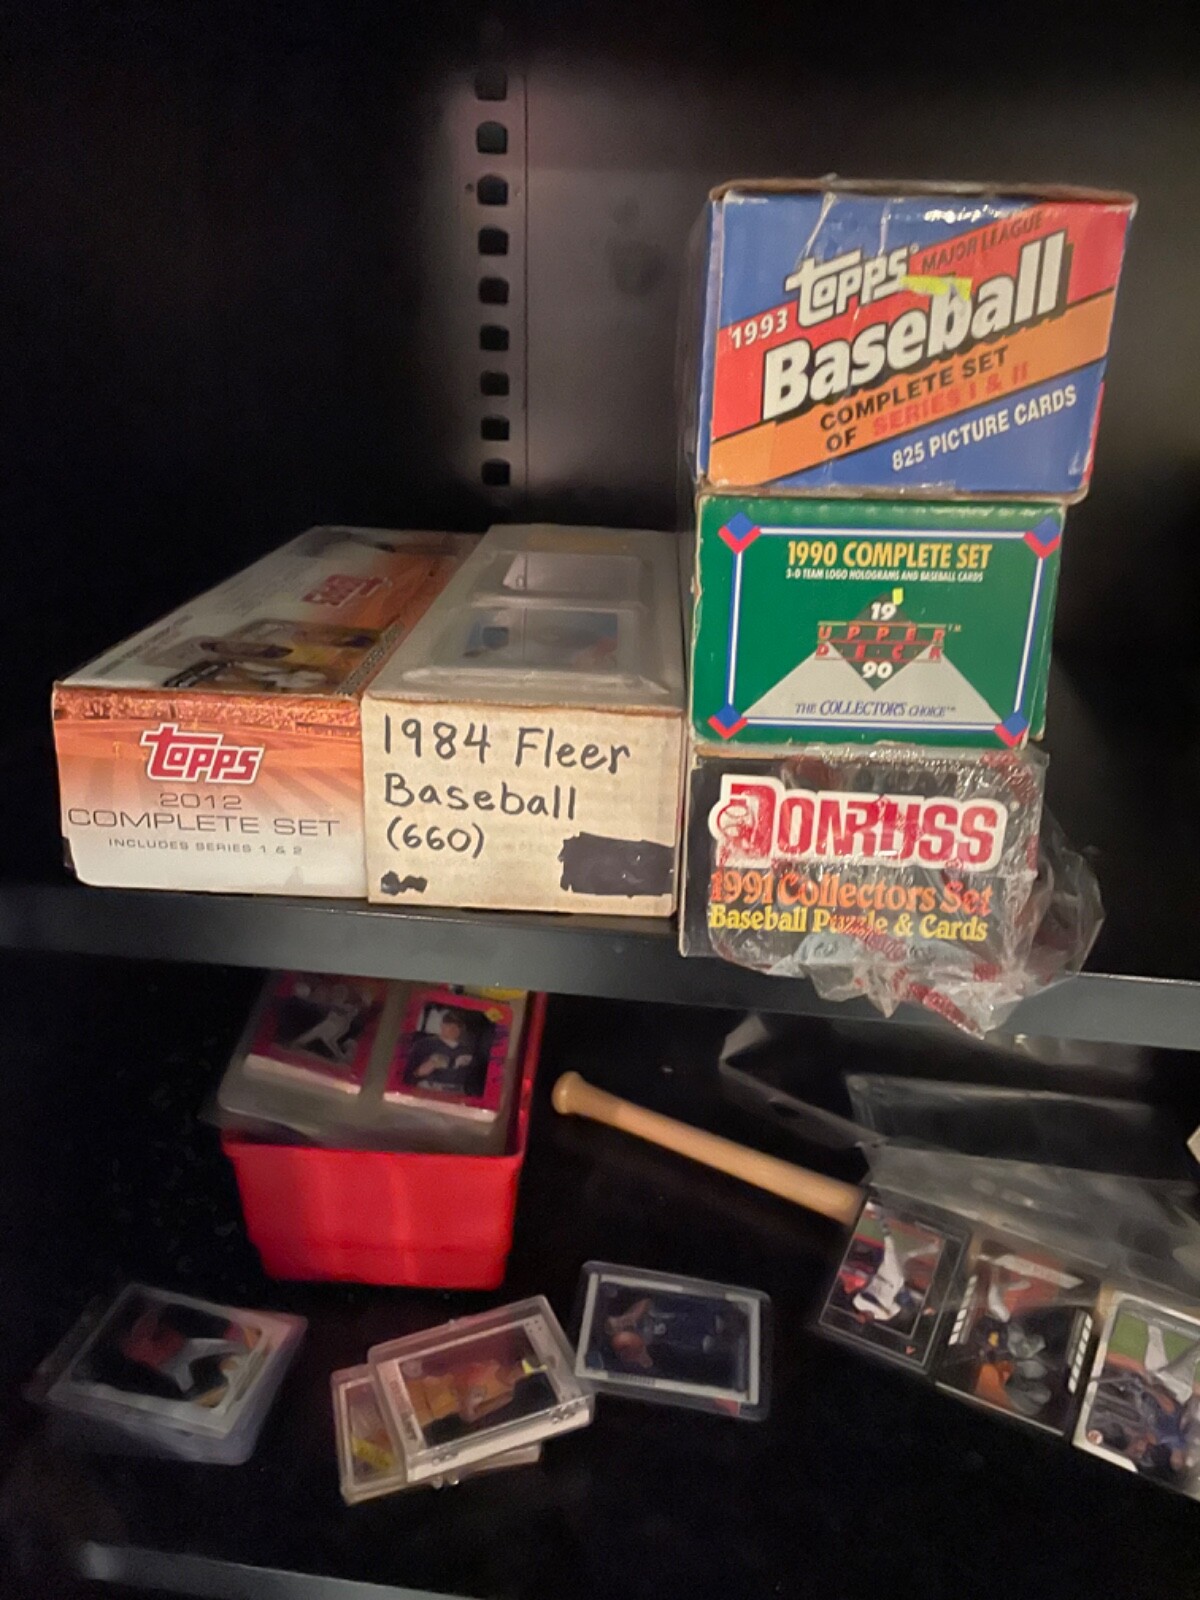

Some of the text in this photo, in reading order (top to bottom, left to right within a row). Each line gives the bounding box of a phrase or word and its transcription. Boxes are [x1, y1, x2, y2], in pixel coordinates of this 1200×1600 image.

[921, 211, 1044, 274] MAJOR LEAGUE
[730, 308, 788, 350] 1993
[763, 230, 1068, 420] Baseball
[820, 345, 1010, 431] COMPLETE SET
[826, 361, 1029, 453] OF SERIES I & II
[892, 384, 1078, 472] 825 PICTURE CARDS
[787, 541, 992, 569] 1990 COMPLETE SET
[803, 568, 824, 581] TEAM
[825, 568, 848, 581] LOGO
[849, 569, 900, 582] HOLOGRAMS
[901, 570, 919, 582] AND
[919, 570, 956, 583] BASEBALL
[957, 571, 984, 583] CARDS
[871, 602, 898, 621] 19
[862, 661, 893, 679] 90
[795, 702, 818, 715] THE
[384, 713, 631, 774] 1984 Fleer
[160, 792, 242, 811] 2012
[384, 772, 577, 820] Baseball
[67, 808, 341, 838] COMPLETE SET
[386, 816, 485, 859] (660)
[711, 777, 1005, 869] DONRUSS
[108, 838, 303, 856] INCLUDES SERIES 1 & 2
[711, 872, 993, 917] 1991 Collectors Set
[709, 904, 989, 942] Baseball Puzzle & Cards
